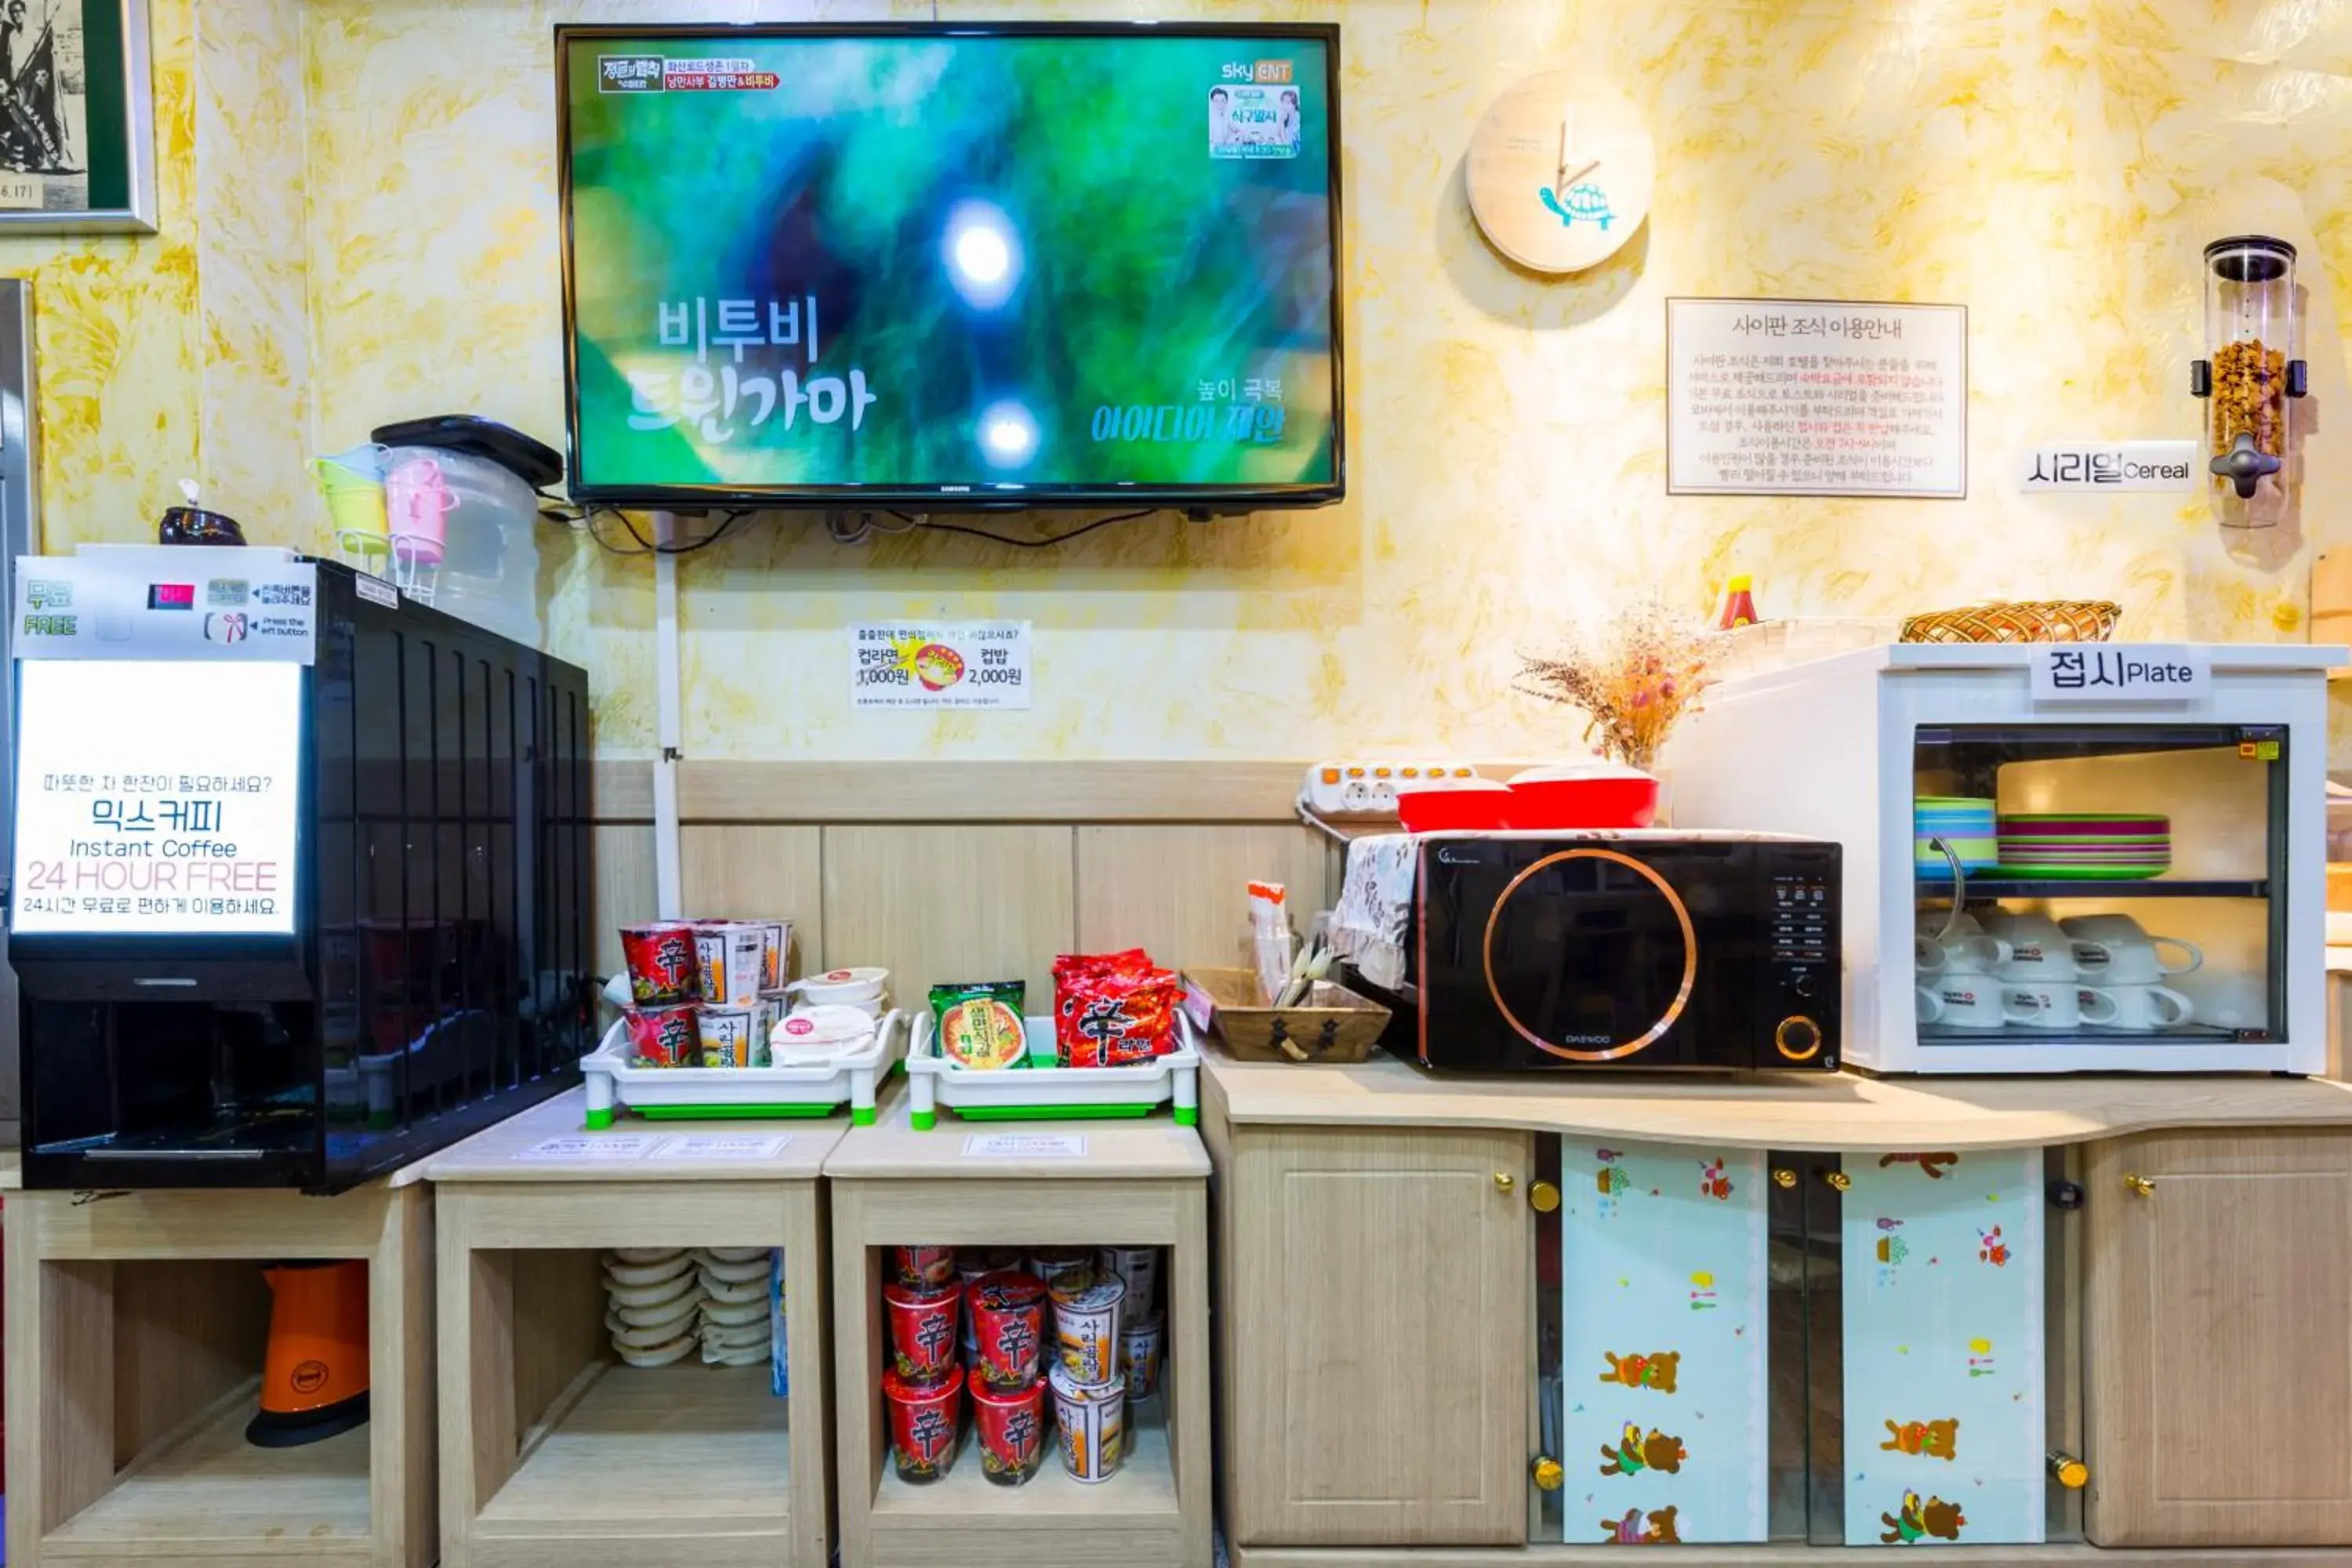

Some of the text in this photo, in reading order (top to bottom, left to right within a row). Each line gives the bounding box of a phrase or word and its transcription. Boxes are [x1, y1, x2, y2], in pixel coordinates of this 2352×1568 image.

[1221, 62, 1254, 82] sky
[659, 296, 818, 363] 비투비
[1732, 314, 1788, 337] 사이판
[1790, 314, 1827, 337] 조식
[1197, 378, 1283, 401] 높이 극복
[626, 365, 877, 445] 트윈가마
[1091, 404, 1216, 442] 아이디어
[2027, 452, 2190, 484] 시리얼 Cereal
[24, 614, 78, 635] FREE
[277, 628, 309, 637] button
[858, 648, 898, 665] 컵라면
[980, 648, 1009, 665] 컵밥
[2049, 651, 2194, 688] 접시 Plate
[858, 668, 909, 686] 1,000원
[968, 668, 1022, 687] 2,000원
[43, 773, 94, 793] 따뜻한
[122, 774, 173, 793] 한잔이
[178, 774, 272, 793] 필요하세요?
[92, 799, 223, 833] 믹스커피
[69, 839, 238, 858] Instant Coffee
[27, 860, 278, 891] 24 HOUR FREE
[23, 897, 77, 914] 24시간
[82, 898, 133, 915] 무료로
[655, 938, 688, 985] 辛
[658, 1017, 691, 1065] 辛
[1078, 994, 1137, 1067] 辛
[1566, 1034, 1611, 1044] DAEWOO
[1117, 1038, 1152, 1053] 라면
[916, 1313, 952, 1364] 辛
[997, 1318, 1034, 1371] 辛
[911, 1410, 949, 1461] 辛
[1004, 1410, 1038, 1460] 辛
